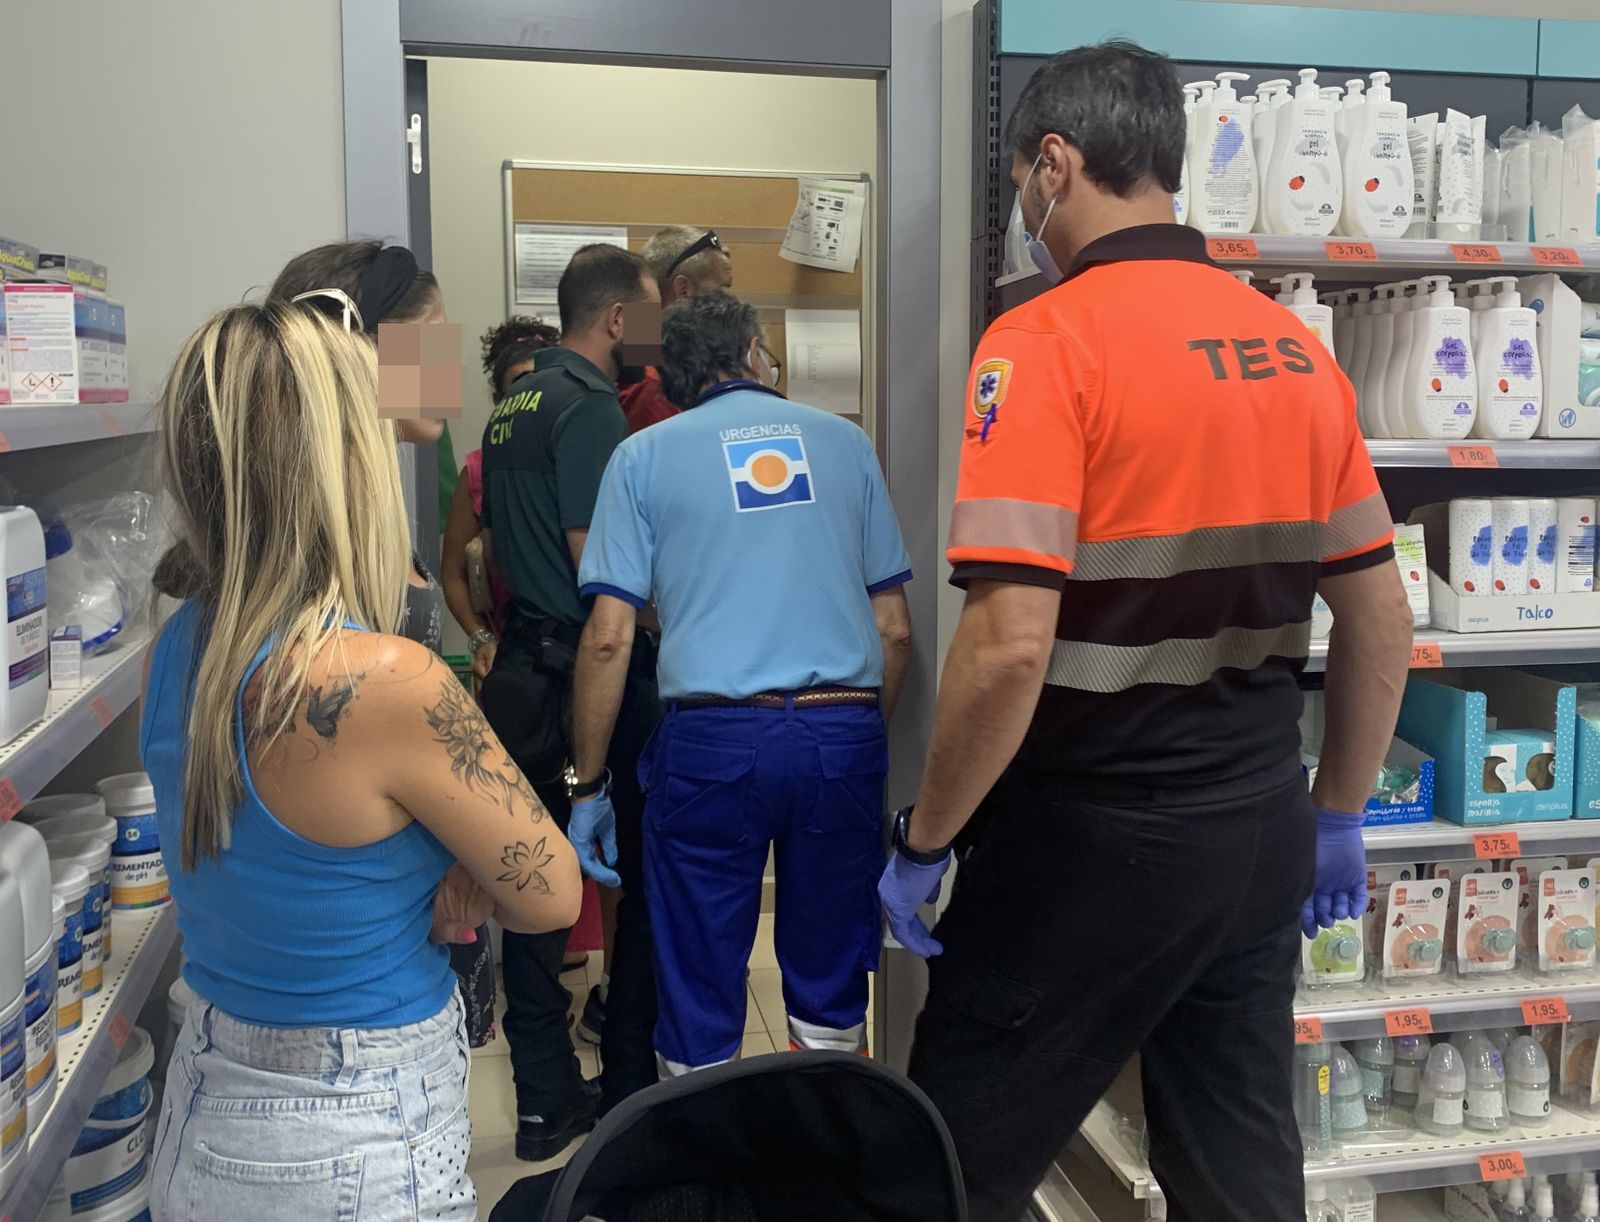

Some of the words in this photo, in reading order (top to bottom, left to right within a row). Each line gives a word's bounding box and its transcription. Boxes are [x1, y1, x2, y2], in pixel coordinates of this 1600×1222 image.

[1187, 337, 1315, 380] TES
[719, 424, 802, 441] URGENCIAS
[1516, 604, 1554, 621] Talco
[1412, 649, 1433, 661] ,75€
[112, 859, 163, 872] REMENTAD
[1295, 1021, 1313, 1034] 95€
